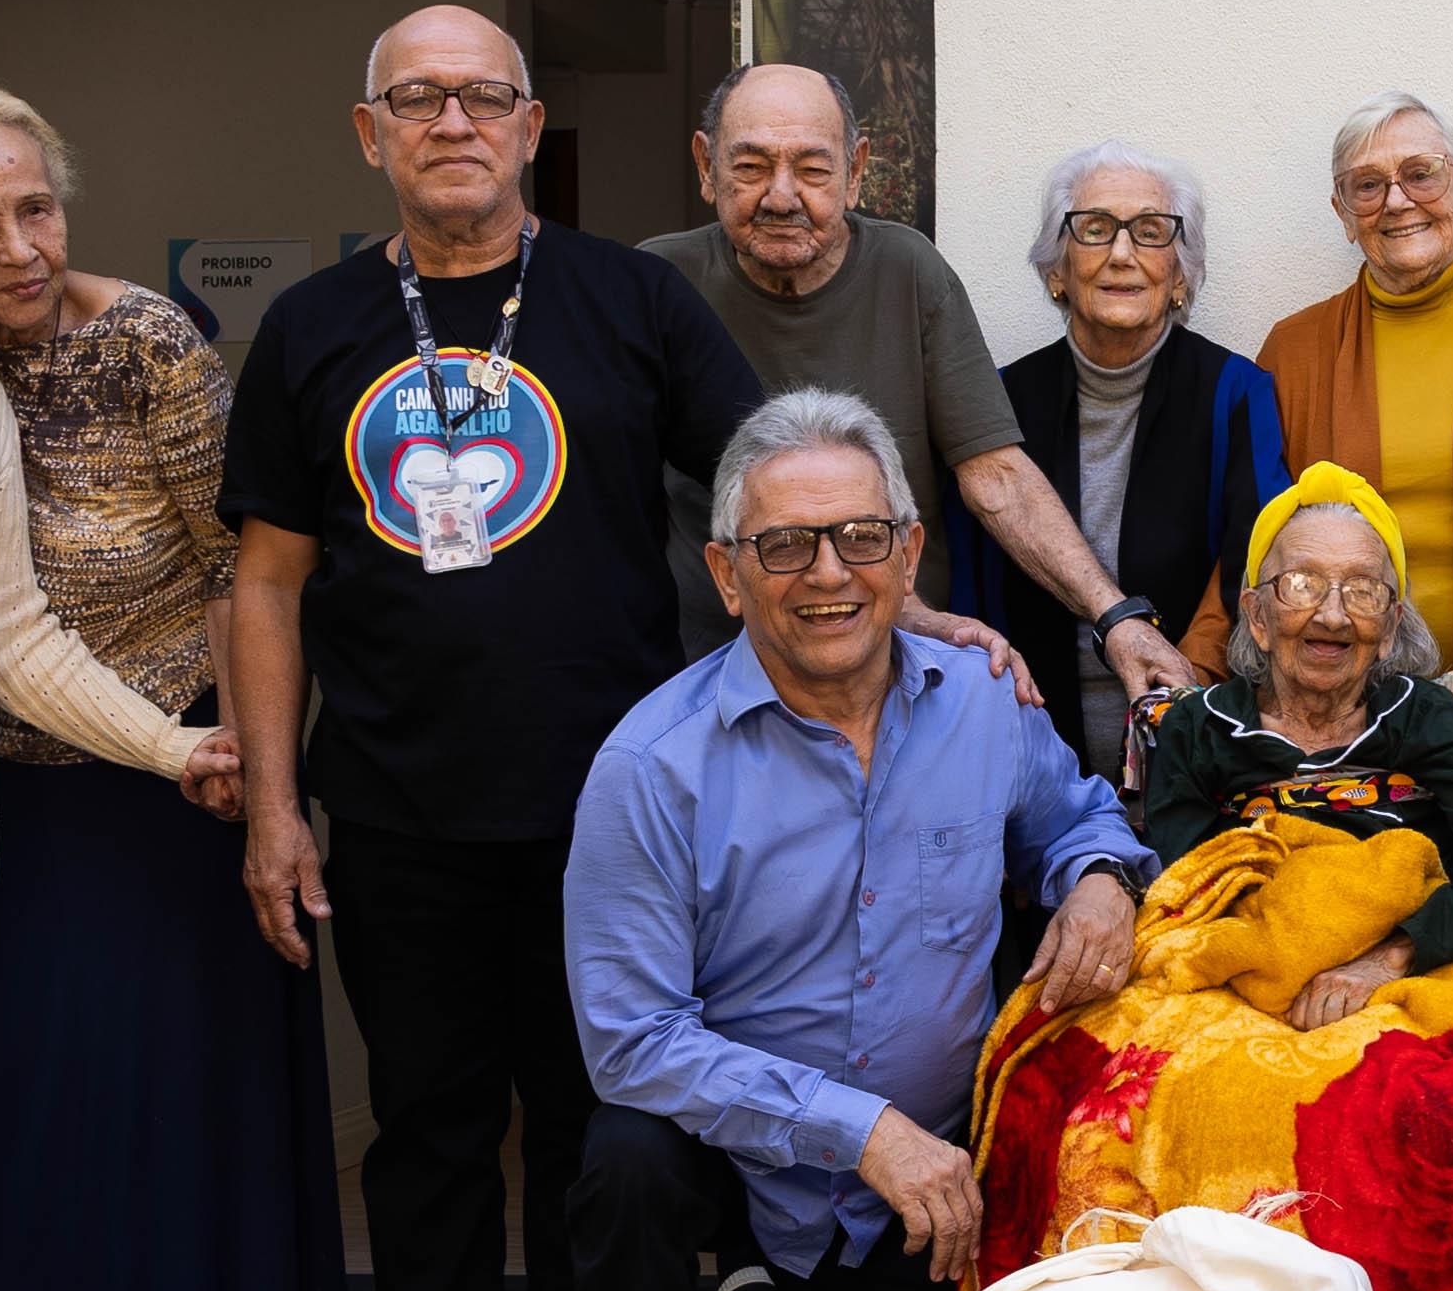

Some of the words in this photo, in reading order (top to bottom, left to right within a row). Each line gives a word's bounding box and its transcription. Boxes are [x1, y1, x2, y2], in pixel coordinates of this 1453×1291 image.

[201, 256, 273, 270] PROIBIDO
[201, 275, 253, 289] FUMAR
[394, 409, 512, 437] AGAALHO
